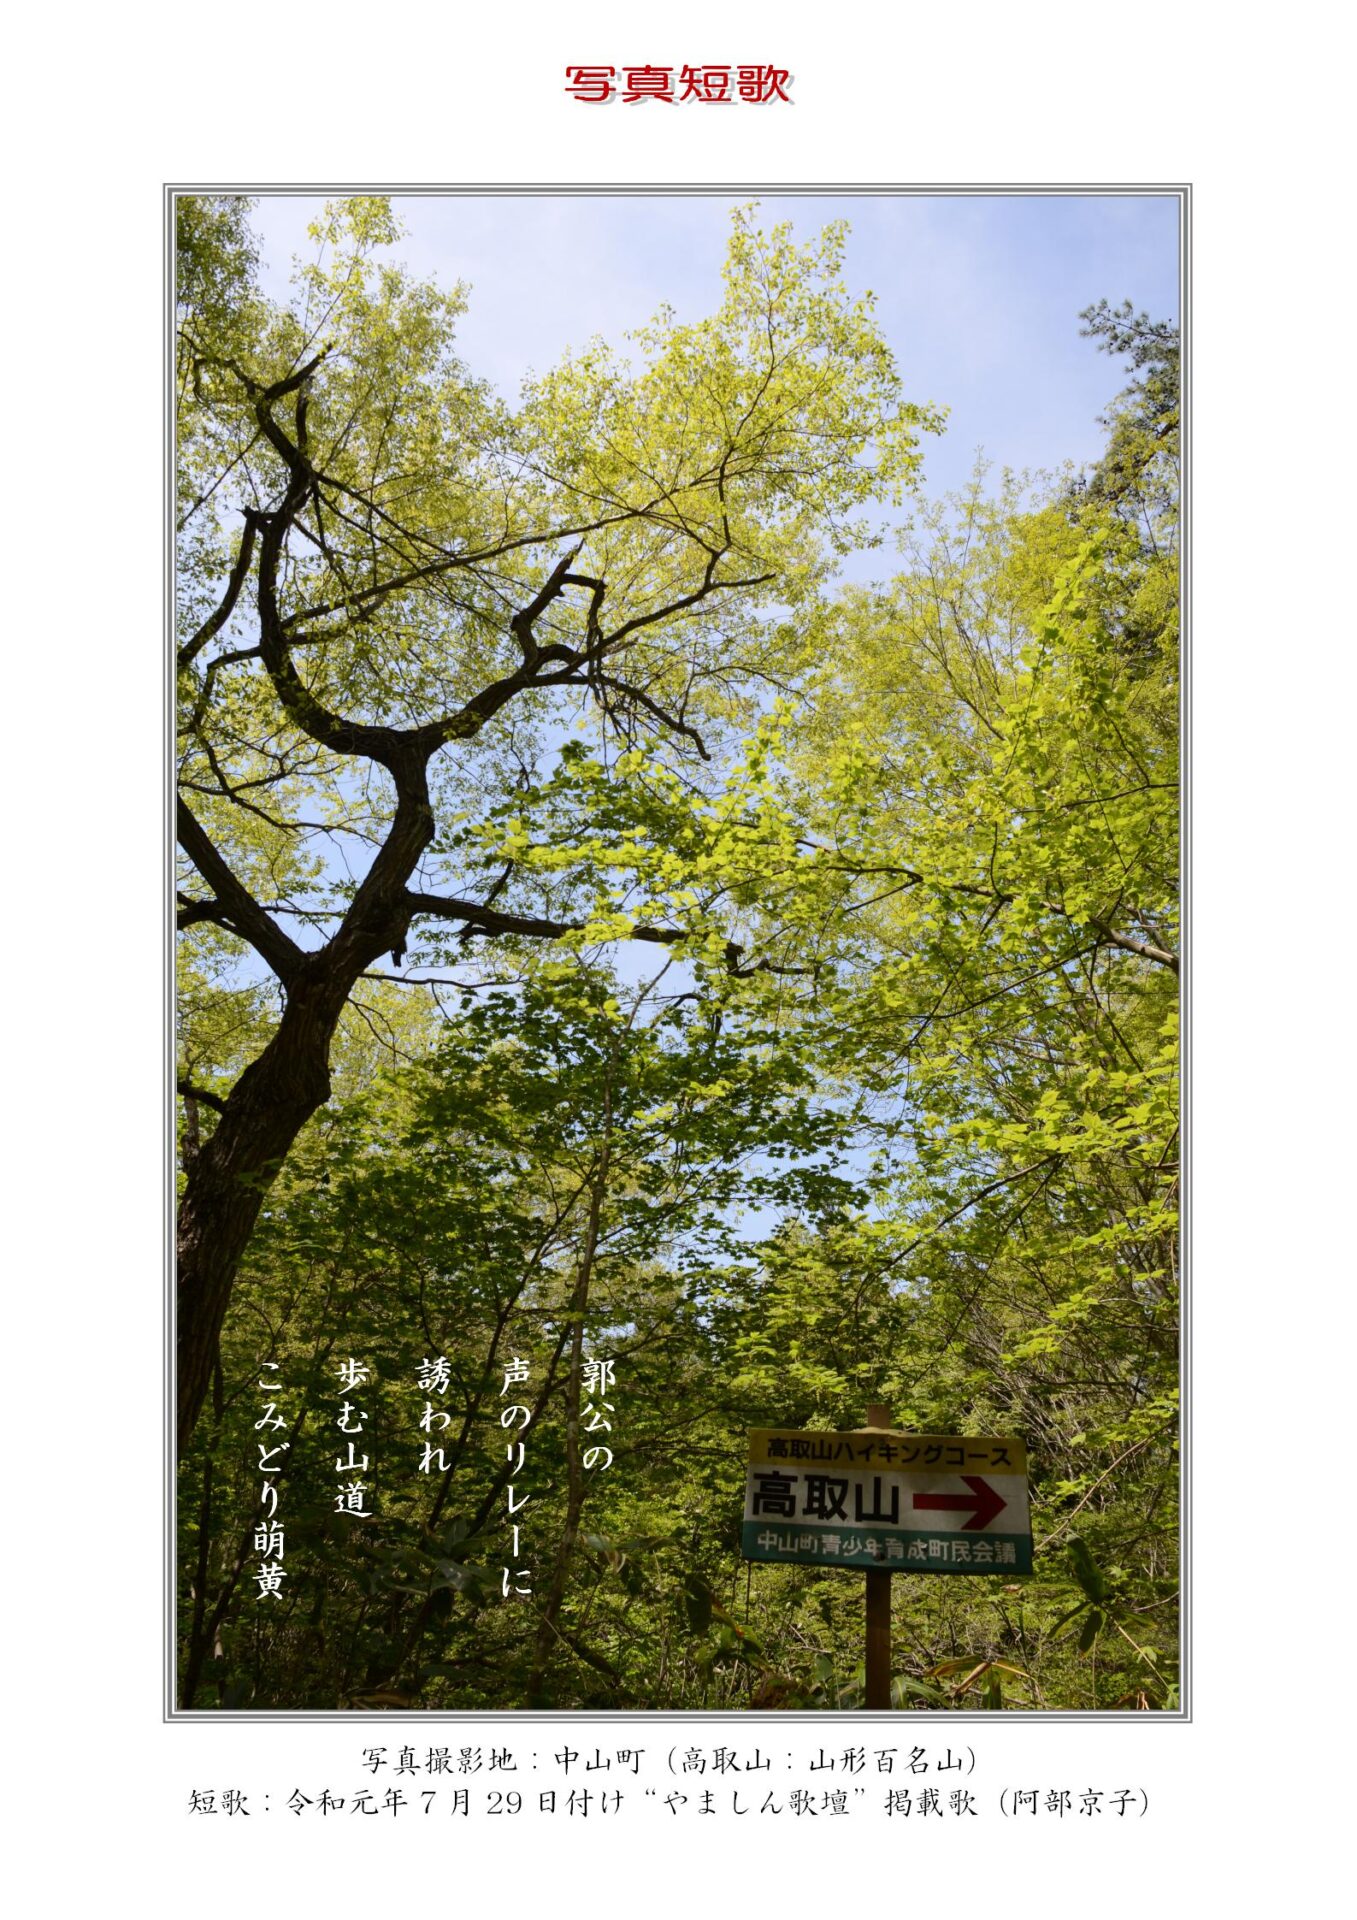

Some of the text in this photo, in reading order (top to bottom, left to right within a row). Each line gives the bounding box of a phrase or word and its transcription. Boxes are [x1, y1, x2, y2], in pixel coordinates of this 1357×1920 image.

[766, 1437, 1012, 1467] 高取山ハイキングコース
[752, 1470, 900, 1525] 高取山
